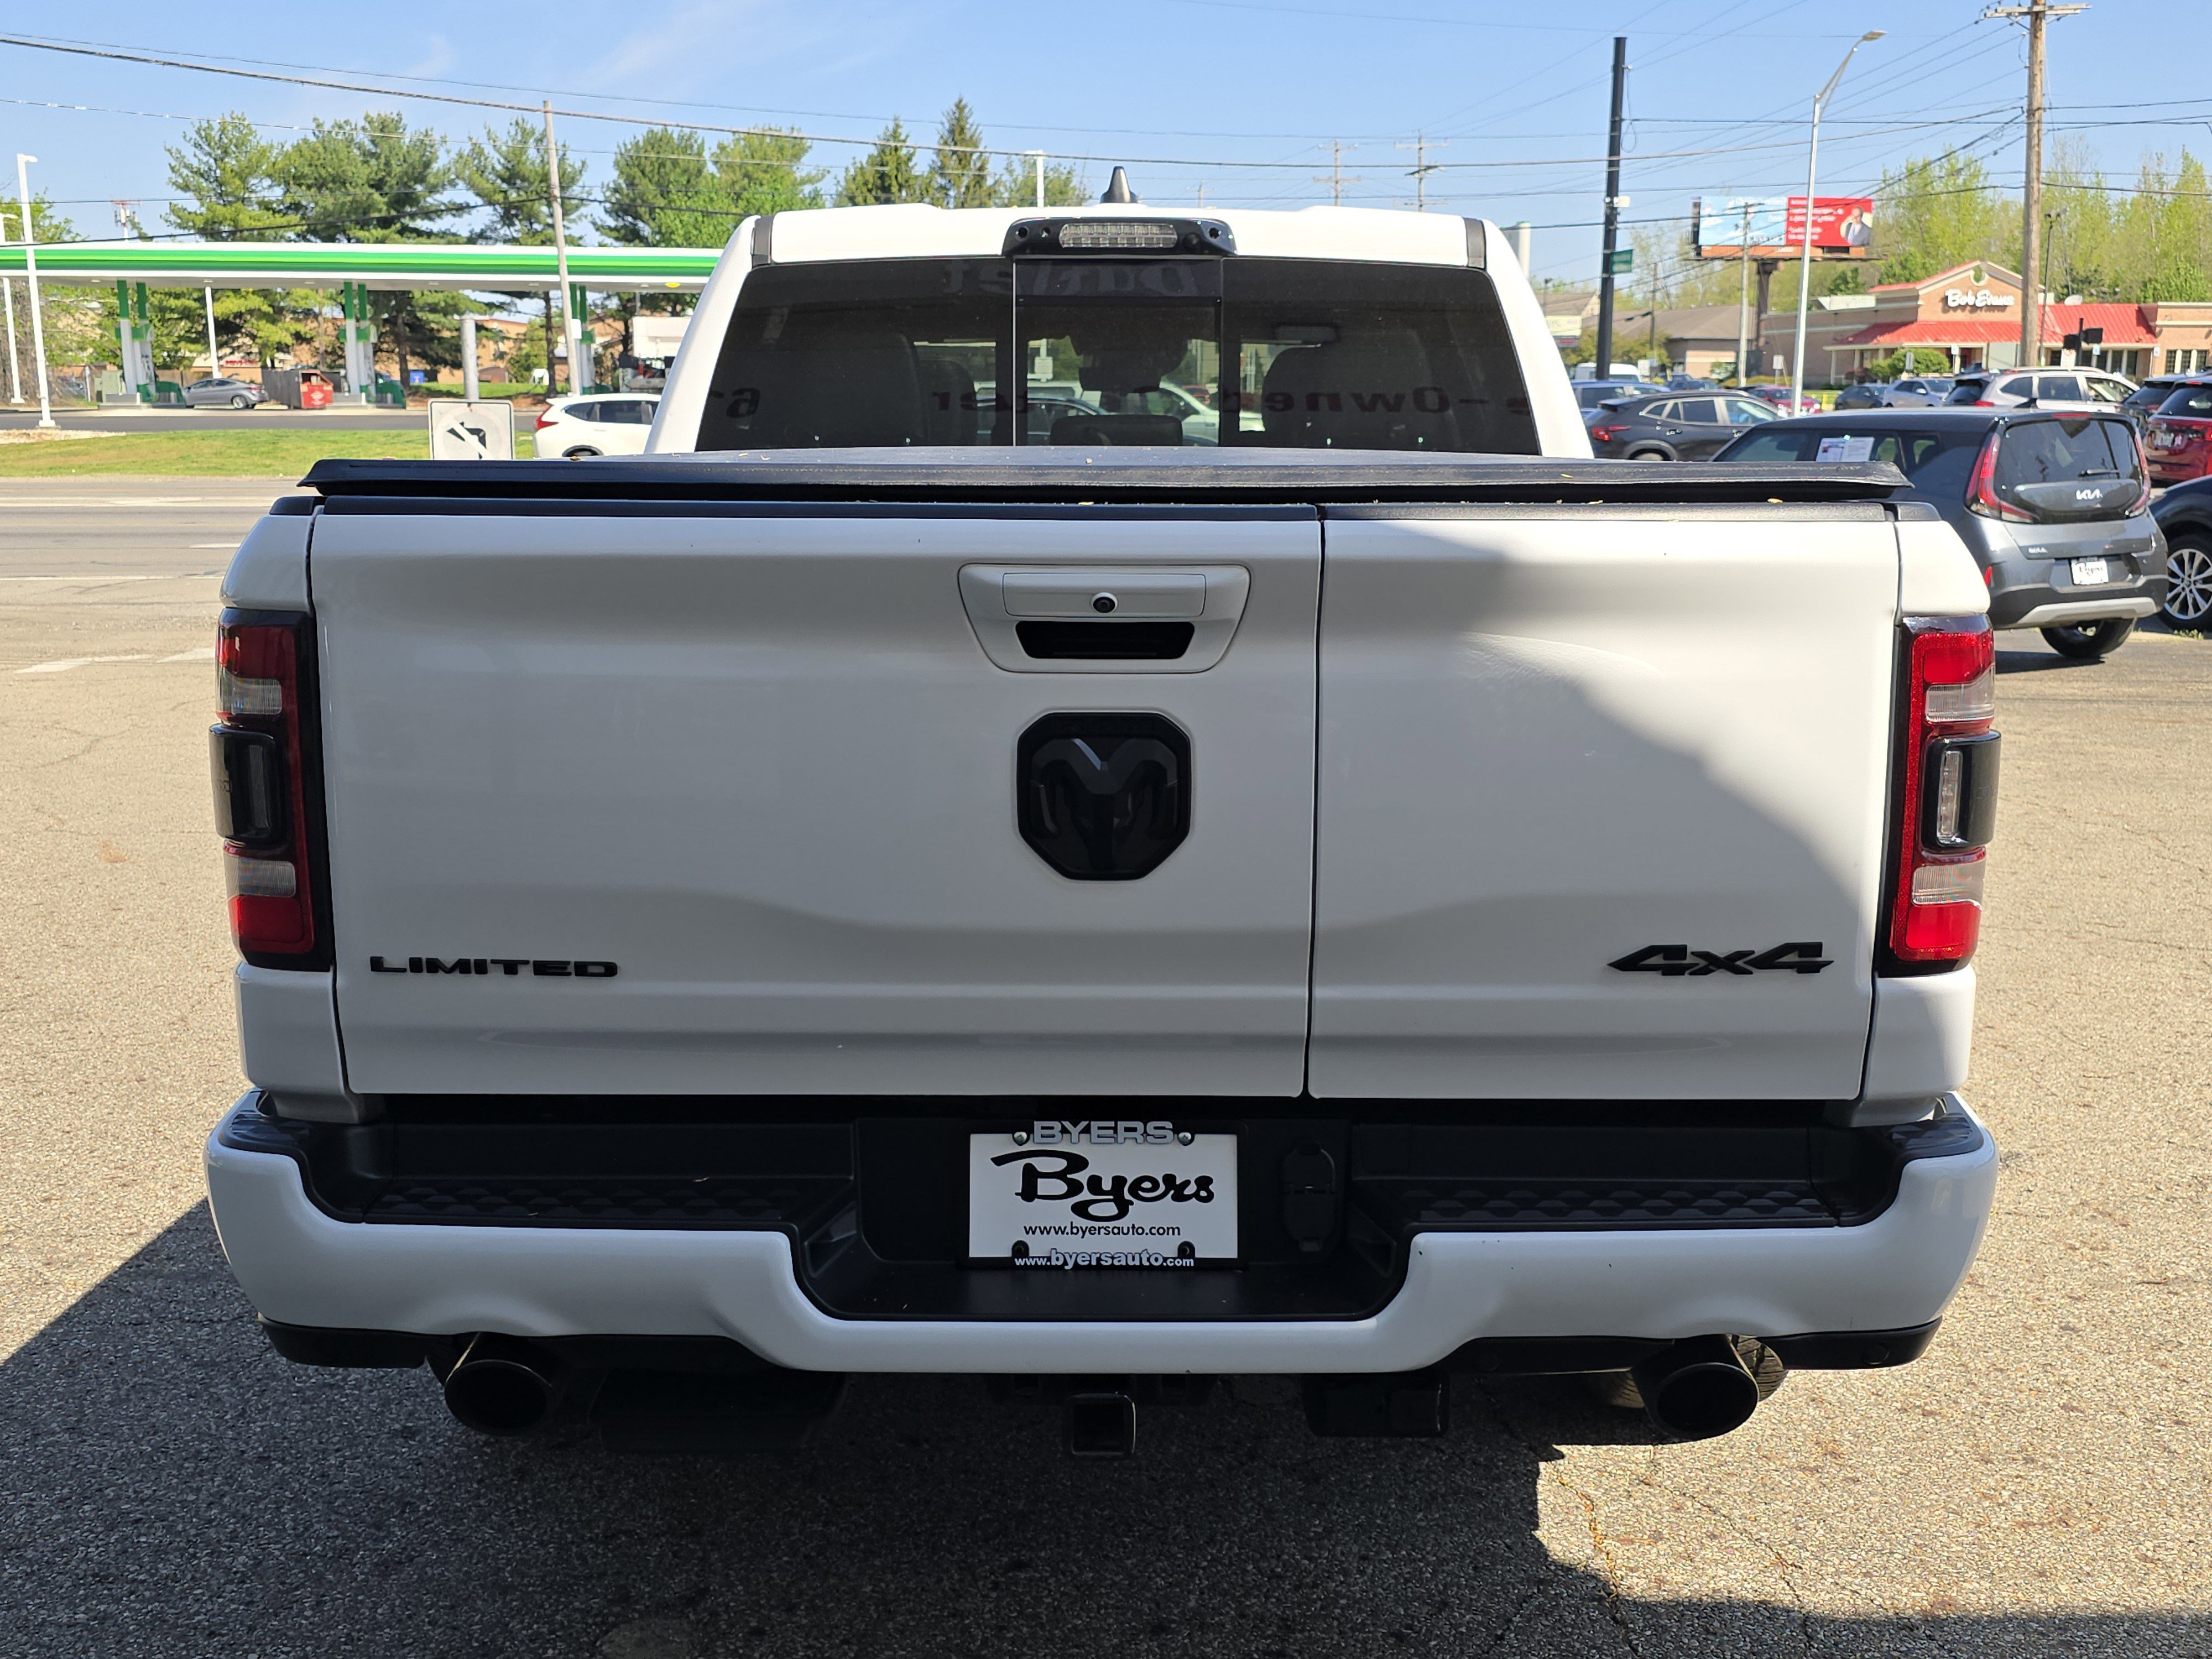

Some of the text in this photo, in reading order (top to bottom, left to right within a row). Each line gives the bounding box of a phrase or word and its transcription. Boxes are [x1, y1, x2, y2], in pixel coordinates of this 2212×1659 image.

[1945, 289, 2015, 307] Bob Evans
[369, 956, 618, 978] LIMITED
[1033, 1120, 1175, 1145] BYERS
[990, 1149, 1215, 1223] Byers
[1023, 1221, 1181, 1239] www.byersauto.com
[1014, 1248, 1195, 1270] www.byersauto.com
